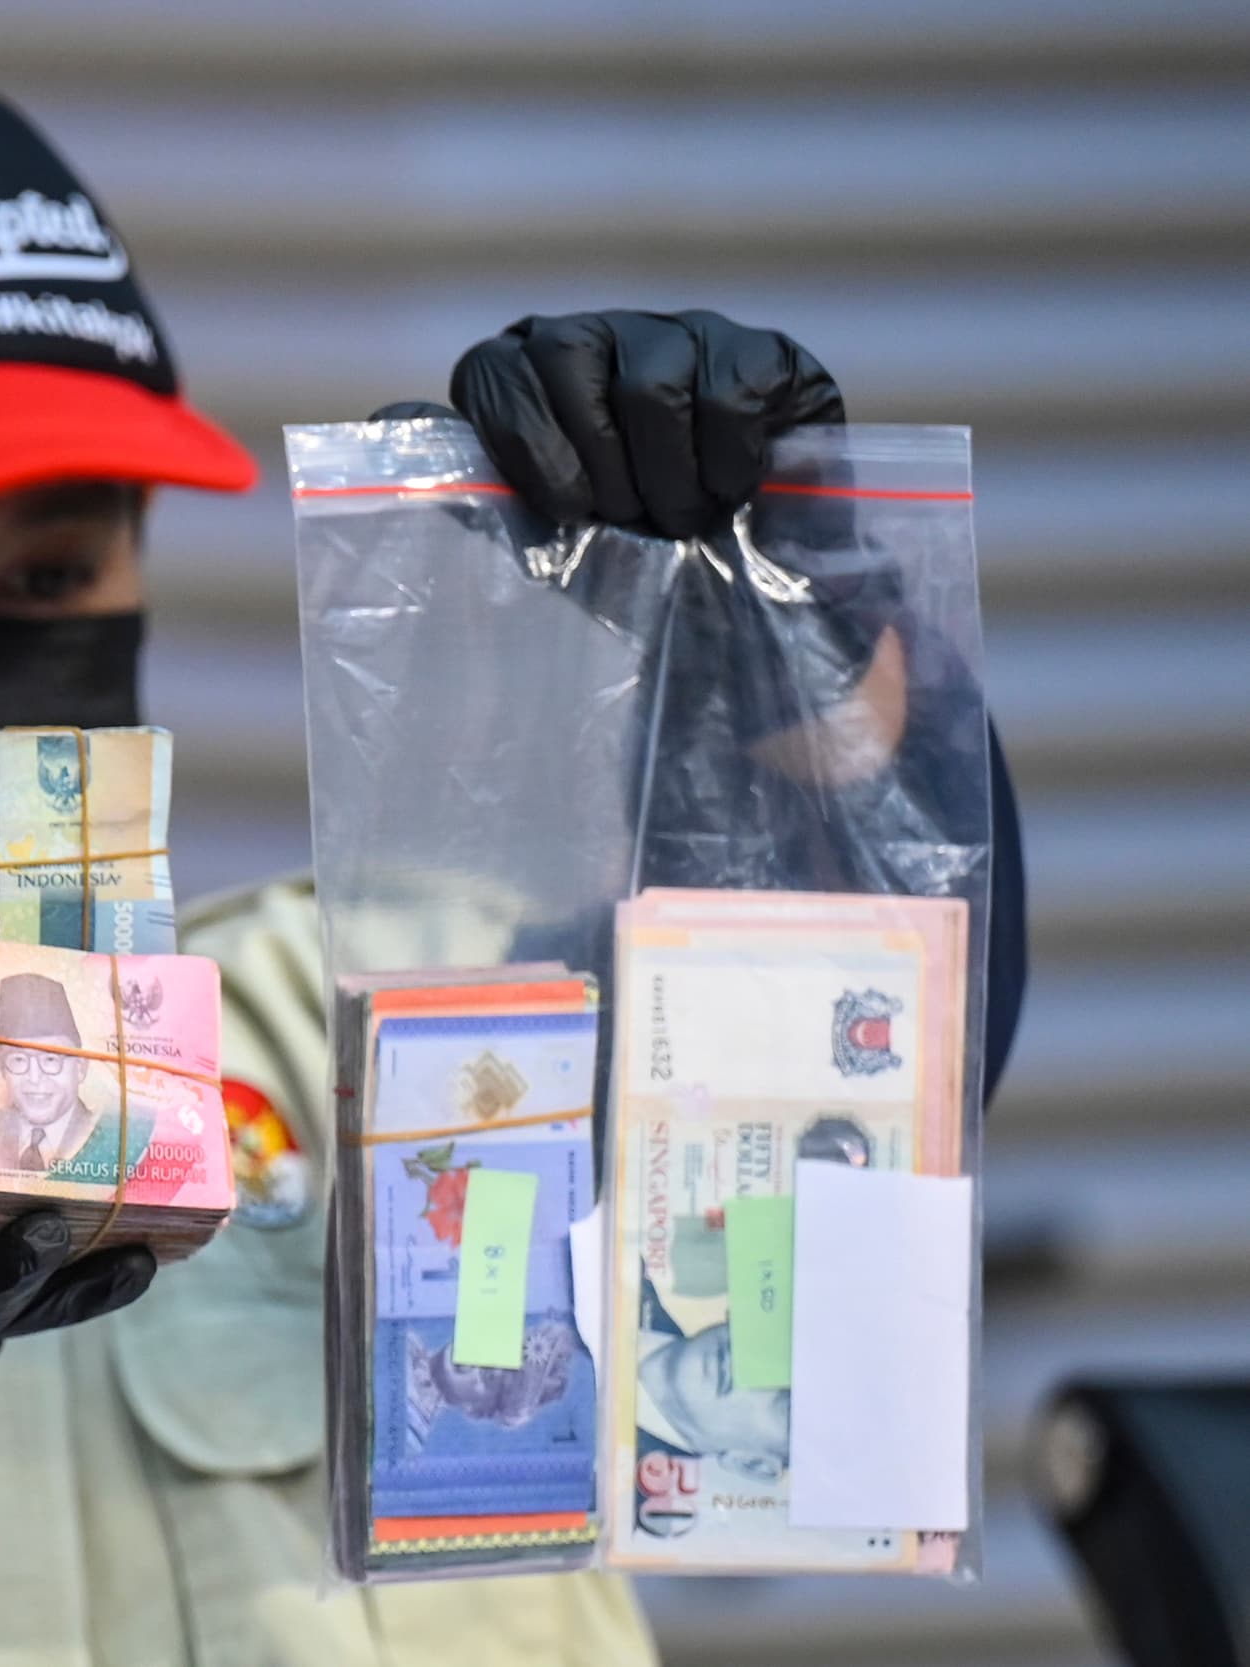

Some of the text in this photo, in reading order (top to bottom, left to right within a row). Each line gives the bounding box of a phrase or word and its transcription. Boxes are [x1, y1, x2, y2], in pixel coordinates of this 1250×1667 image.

[114, 901, 133, 954] 5000
[50, 1160, 109, 1177] SERATUS
[113, 1164, 148, 1179] RBU
[150, 1143, 206, 1163] 100000
[647, 1120, 670, 1277] SINGAPORE
